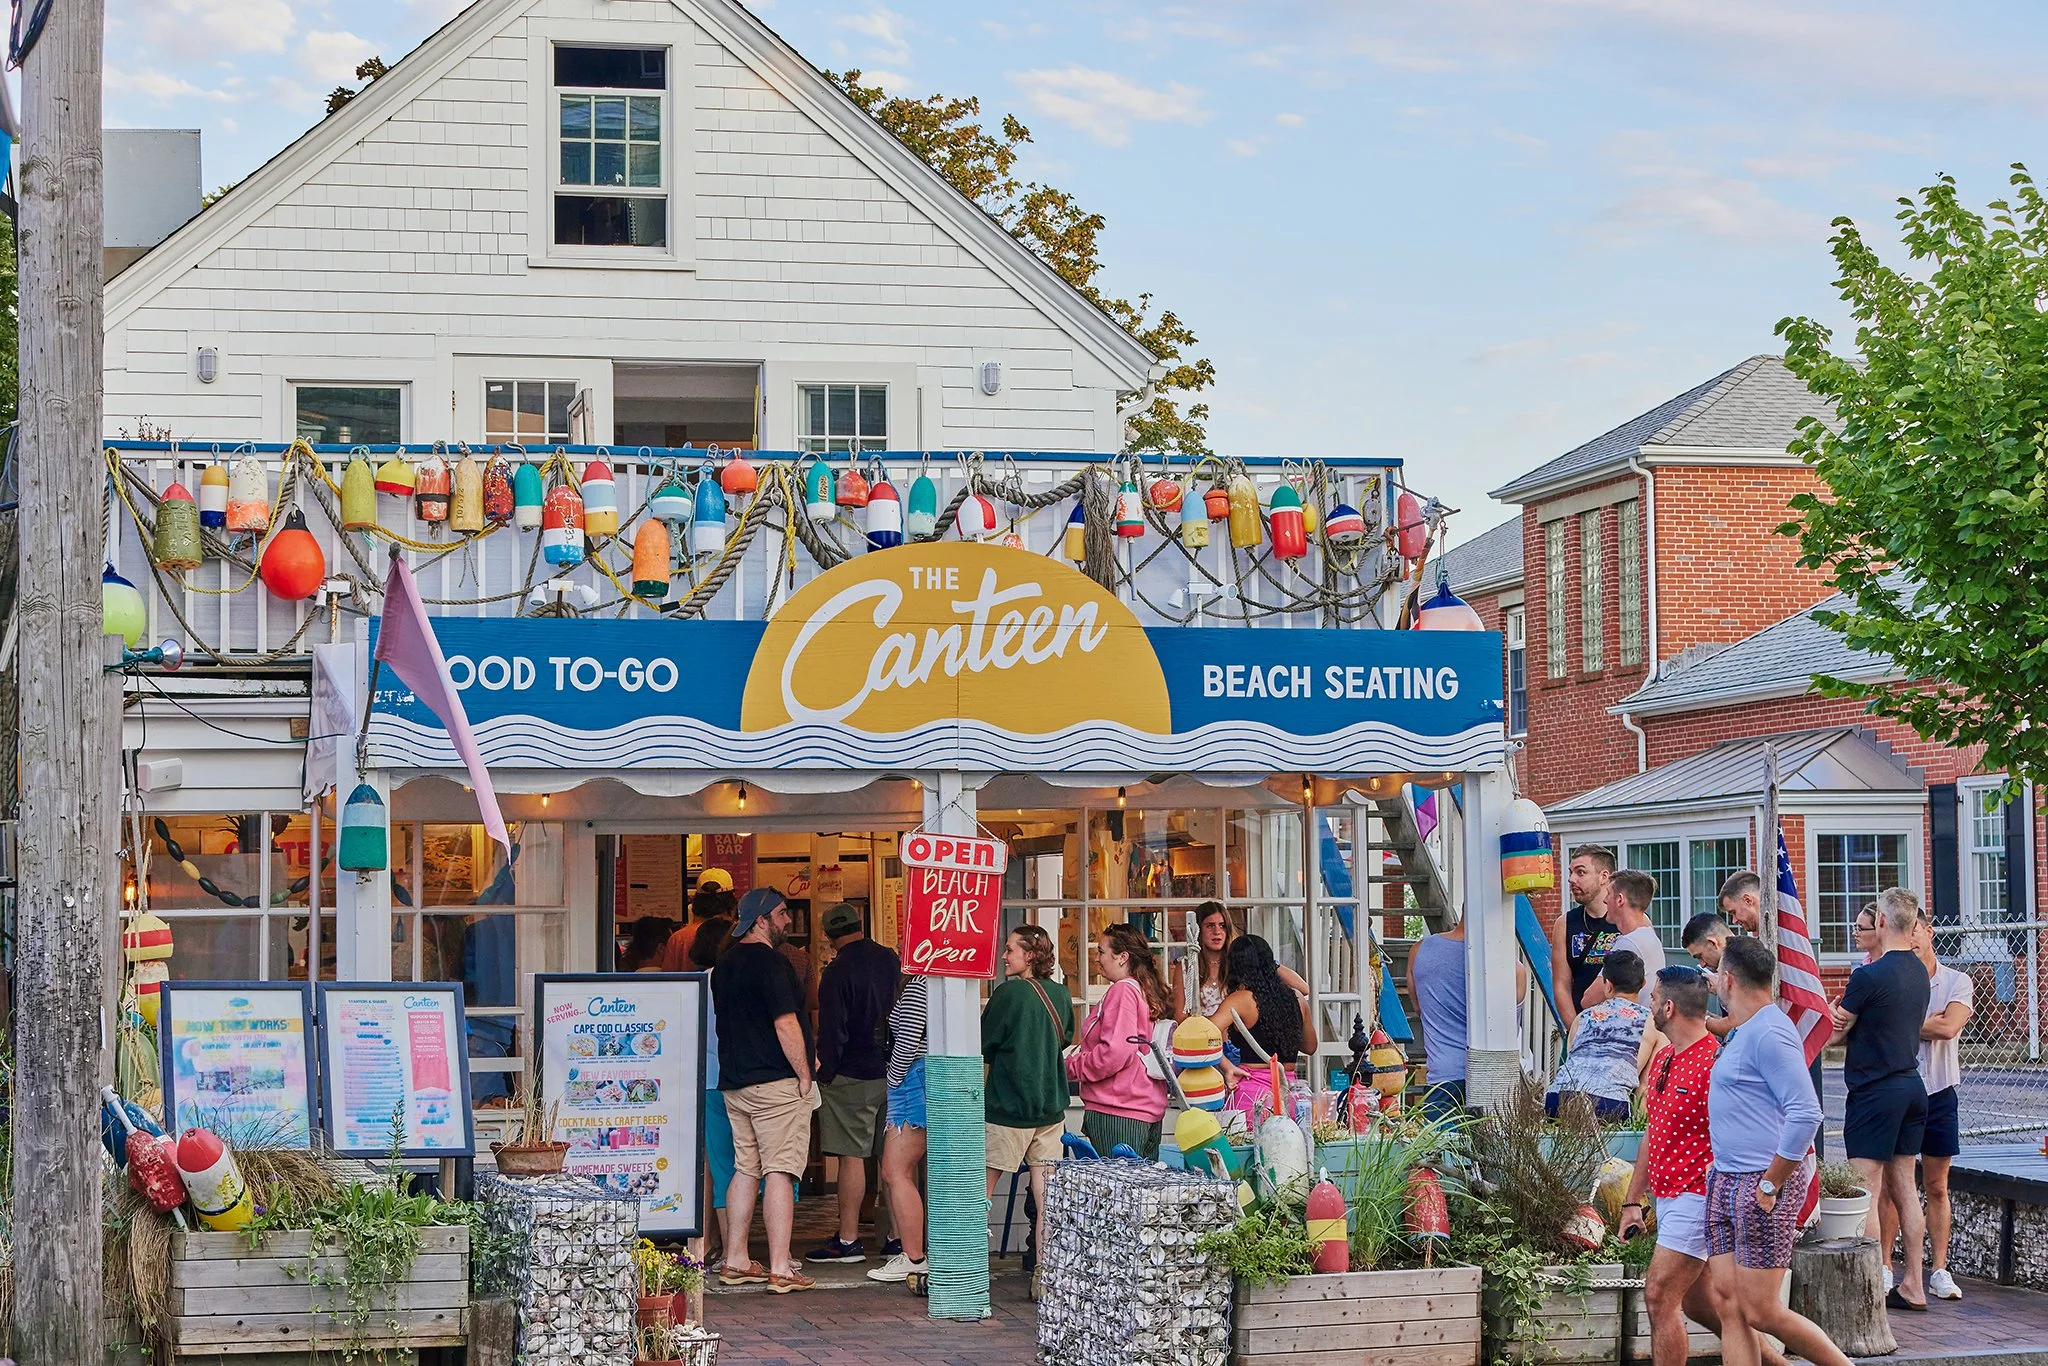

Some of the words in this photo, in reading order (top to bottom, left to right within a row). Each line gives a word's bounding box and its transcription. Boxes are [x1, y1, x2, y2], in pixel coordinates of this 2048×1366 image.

[909, 567, 959, 590] THE
[781, 568, 1108, 722] Canteen
[445, 655, 536, 691] OOD
[549, 656, 679, 692] TO-GO
[1203, 664, 1311, 698] BEACH
[1325, 665, 1459, 700] SEATING
[714, 834, 744, 844] RAW
[716, 844, 743, 854] BAR
[923, 869, 989, 896] BEACH
[930, 897, 983, 934] BAR
[913, 939, 977, 972] Open
[404, 996, 439, 1009] Canteen
[553, 1002, 573, 1014] NOW
[588, 996, 636, 1017] Canteen
[574, 1024, 595, 1034] CAPE
[597, 1023, 613, 1033] COD
[614, 1022, 654, 1033] CLASSICS
[580, 1071, 599, 1081] NEW
[601, 1069, 647, 1080] FAVORITES
[558, 1117, 604, 1128] COCKTAILS
[605, 1117, 612, 1127] &
[614, 1115, 642, 1126] CRAFT
[643, 1115, 668, 1125] BEERS
[572, 1164, 616, 1174] HOMEMADE
[618, 1162, 653, 1173] SWEETS
